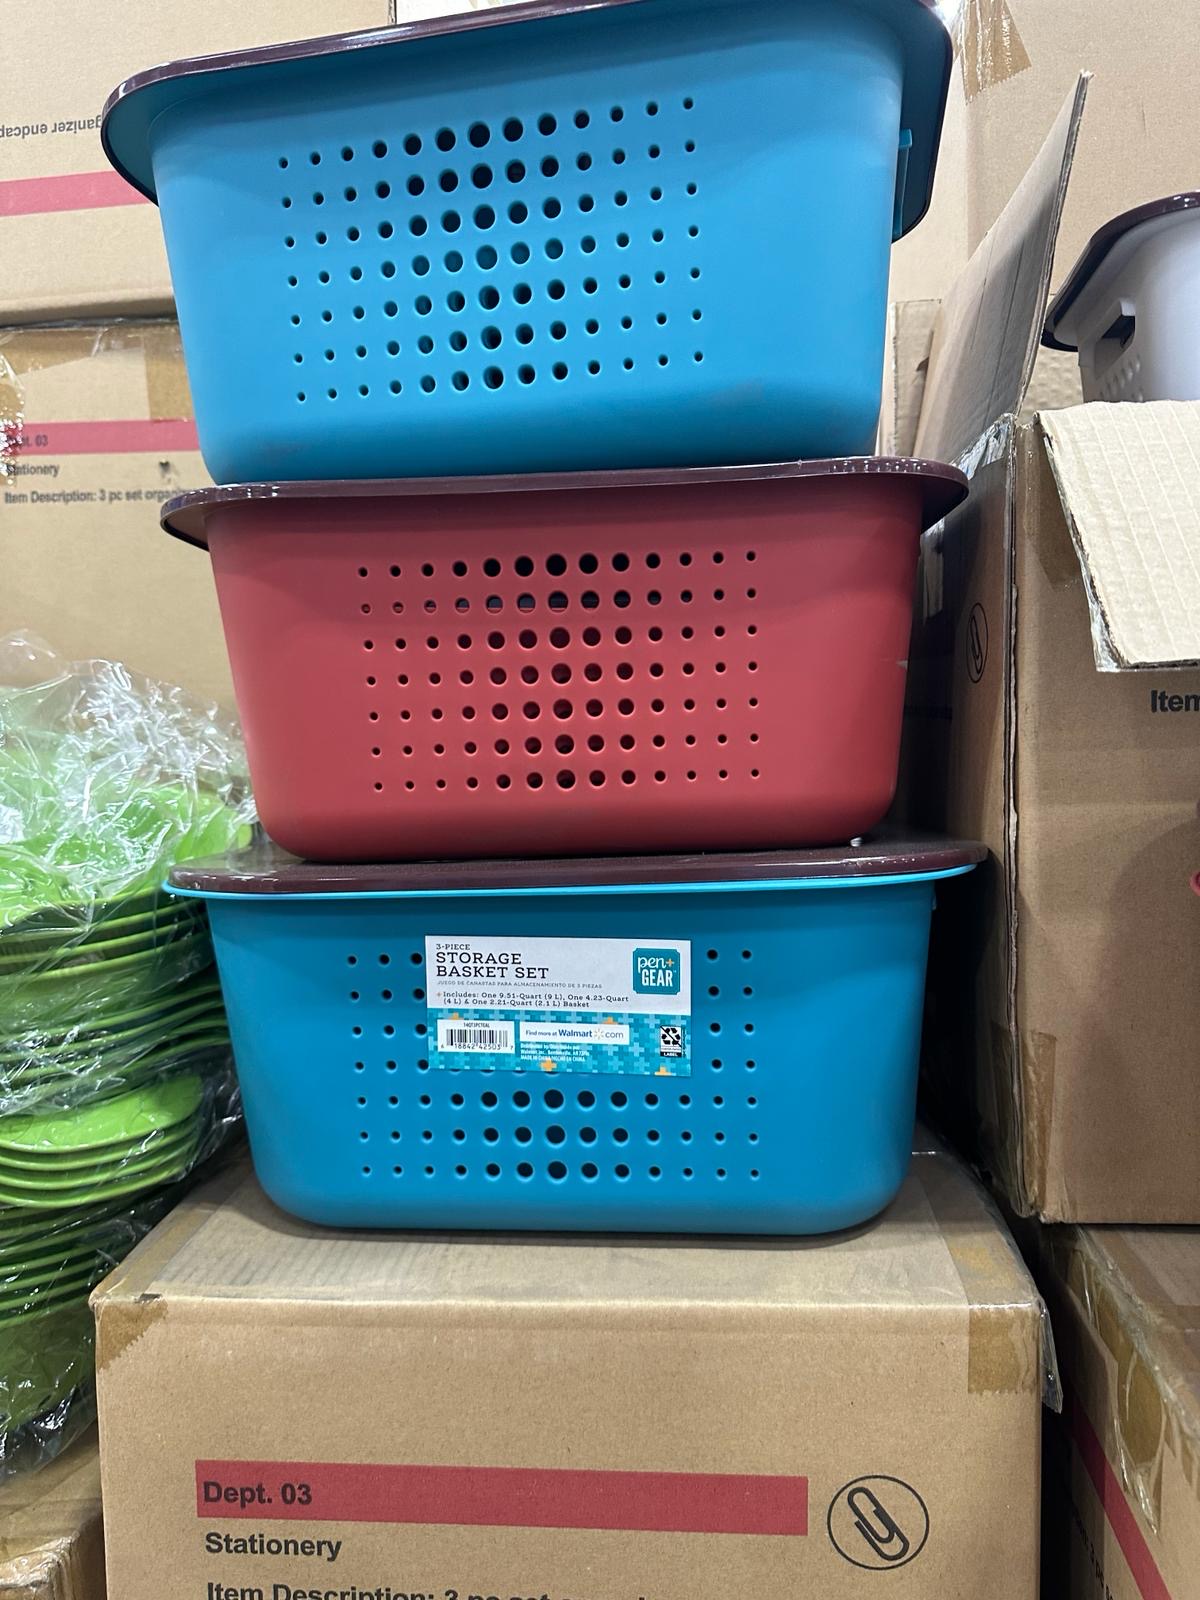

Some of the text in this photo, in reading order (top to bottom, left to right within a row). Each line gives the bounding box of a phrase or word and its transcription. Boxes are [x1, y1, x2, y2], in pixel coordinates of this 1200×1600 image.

[51, 115, 102, 134] ganizer
[35, 434, 48, 447] 03
[5, 492, 28, 504] Item
[30, 490, 97, 504] Description:
[98, 489, 106, 501] 3
[108, 490, 122, 503] pc
[125, 489, 143, 501] set
[436, 943, 471, 951] 3-PIECE
[436, 952, 522, 965] STORAGE
[436, 965, 549, 979] BASKET SET
[443, 998, 452, 1006] (4
[453, 998, 462, 1006] L)
[489, 999, 532, 1007] 2.21-Quart
[499, 992, 542, 1000] 9.51-Quart
[544, 993, 553, 1001] (9
[585, 994, 629, 1003] 4.23-Quart
[558, 1029, 593, 1038] Walmart
[203, 1480, 312, 1509] Dept. 03
[205, 1532, 342, 1562] Stationery
[207, 1582, 263, 1600] Item
